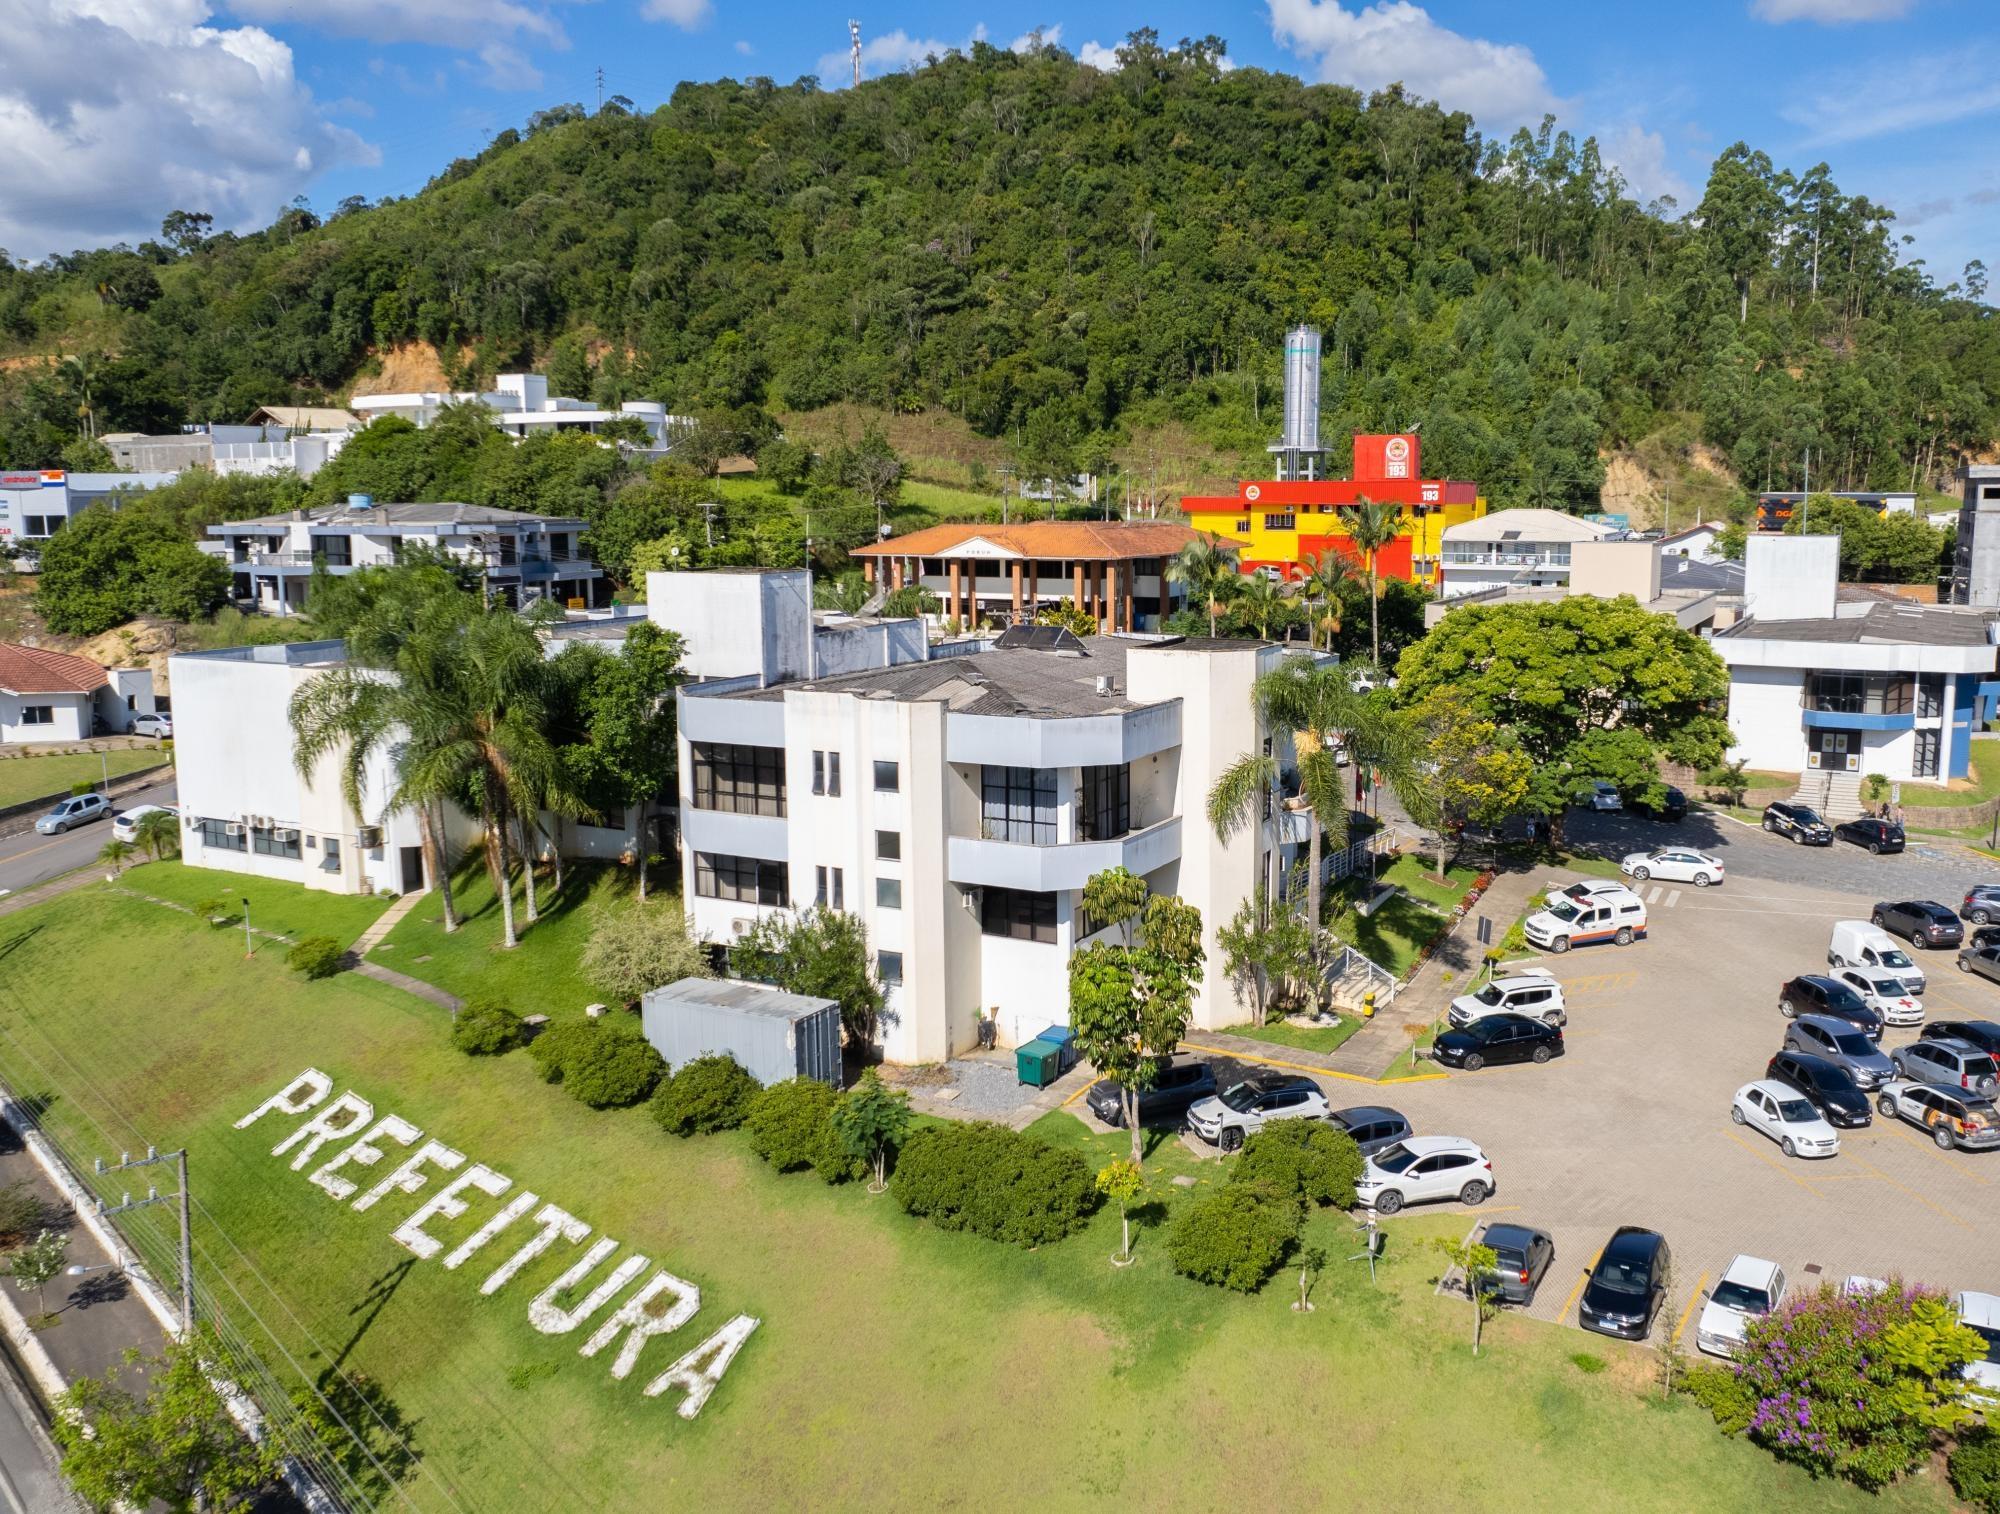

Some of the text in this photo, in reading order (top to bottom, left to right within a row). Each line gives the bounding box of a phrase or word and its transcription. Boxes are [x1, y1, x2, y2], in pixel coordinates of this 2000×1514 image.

[1388, 465, 1406, 476] 193
[1422, 490, 1439, 501] 193
[233, 1067, 761, 1421] PREFEITURA
